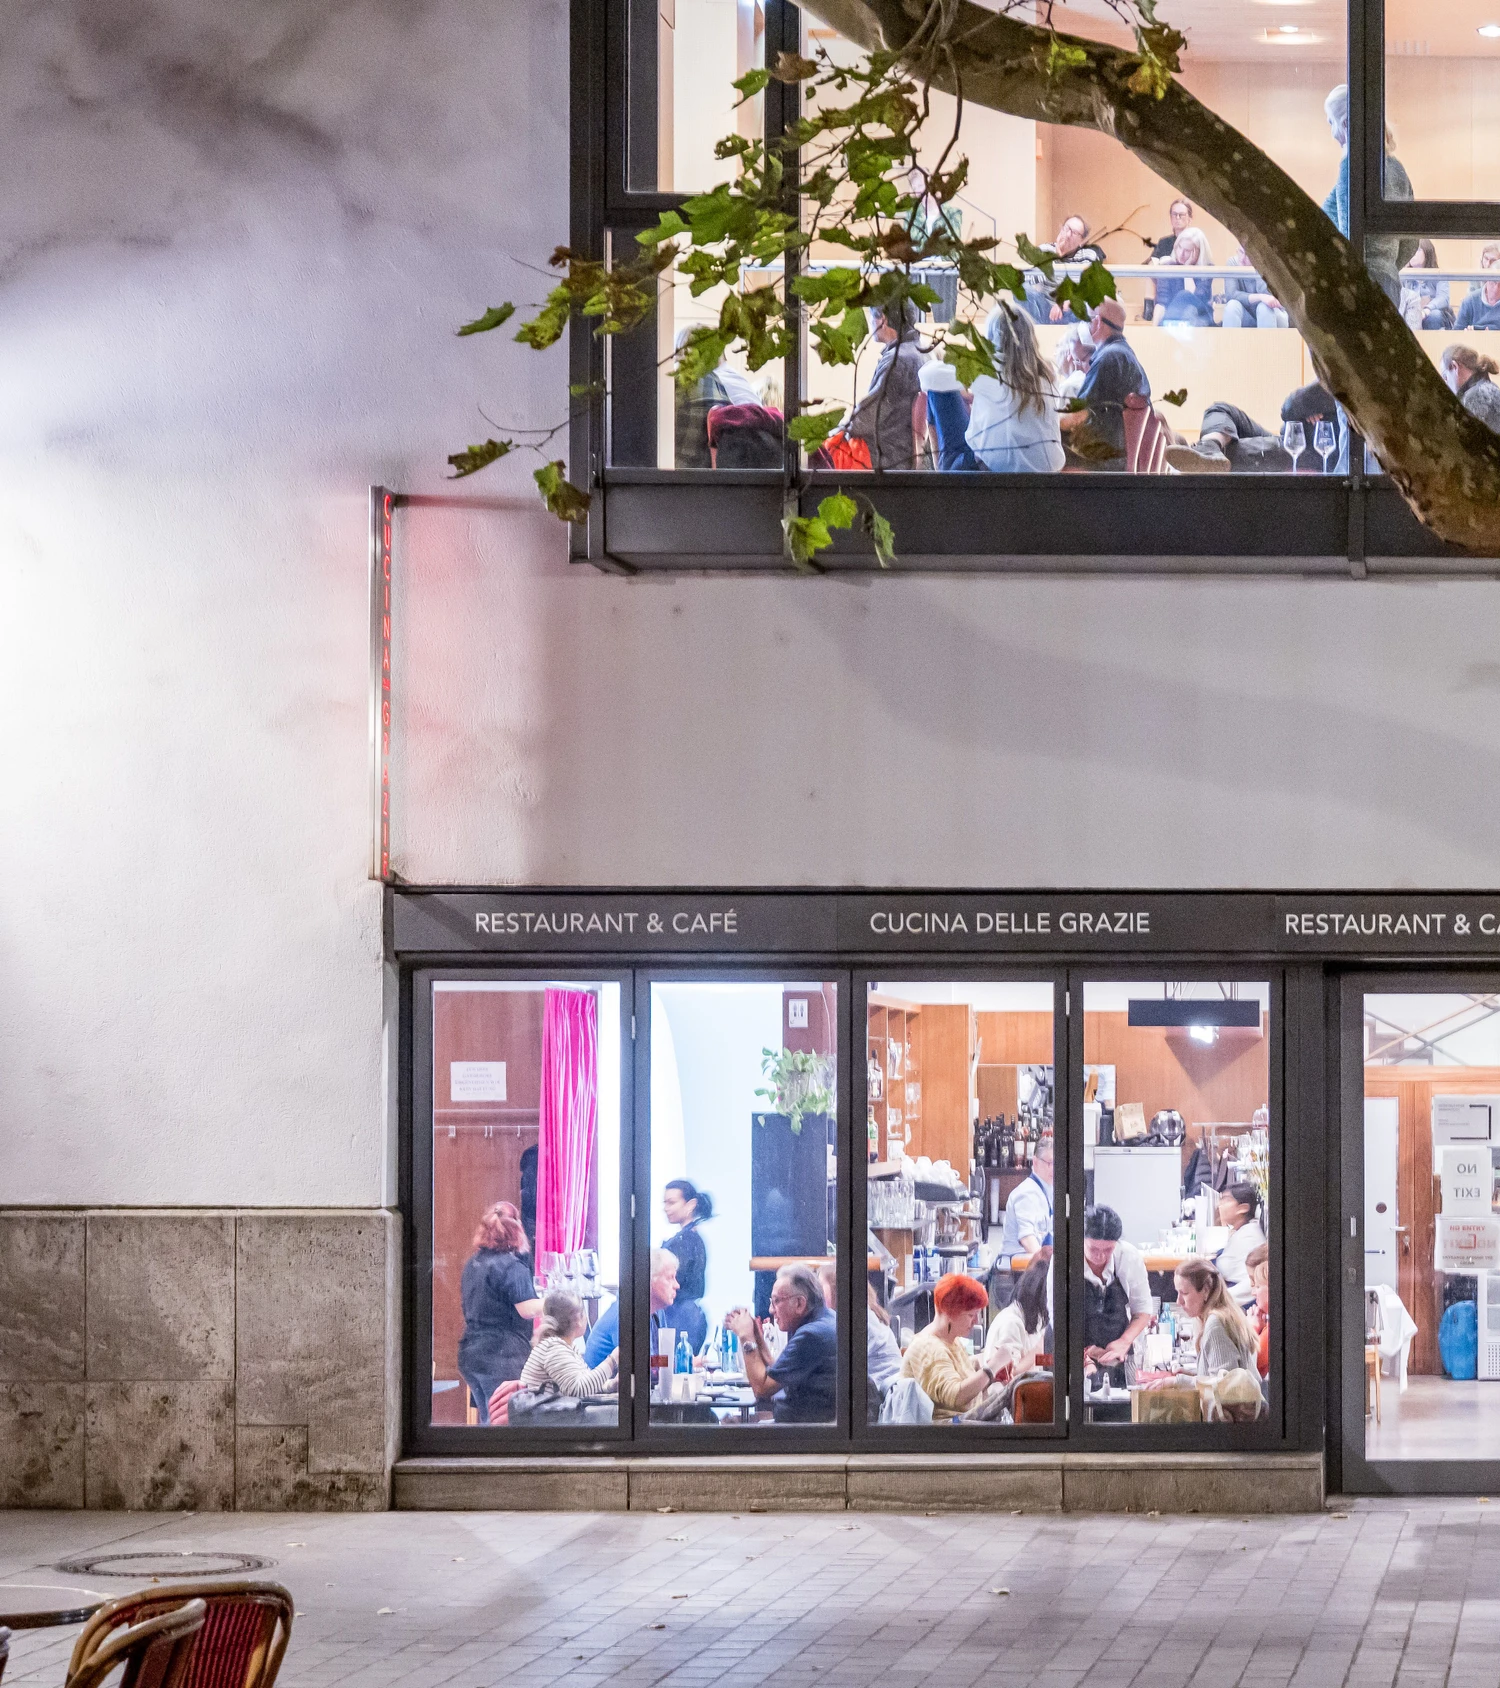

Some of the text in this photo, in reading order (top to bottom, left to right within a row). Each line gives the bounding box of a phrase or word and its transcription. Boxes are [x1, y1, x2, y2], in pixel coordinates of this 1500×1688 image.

[381, 493, 393, 673] CUCINA
[474, 908, 739, 934] RESTAURANT & CAFÉ
[869, 912, 1151, 934] CUCINA DELLE GRAZIE
[1285, 912, 1448, 936] RESTAURANT
[1452, 912, 1473, 936] &
